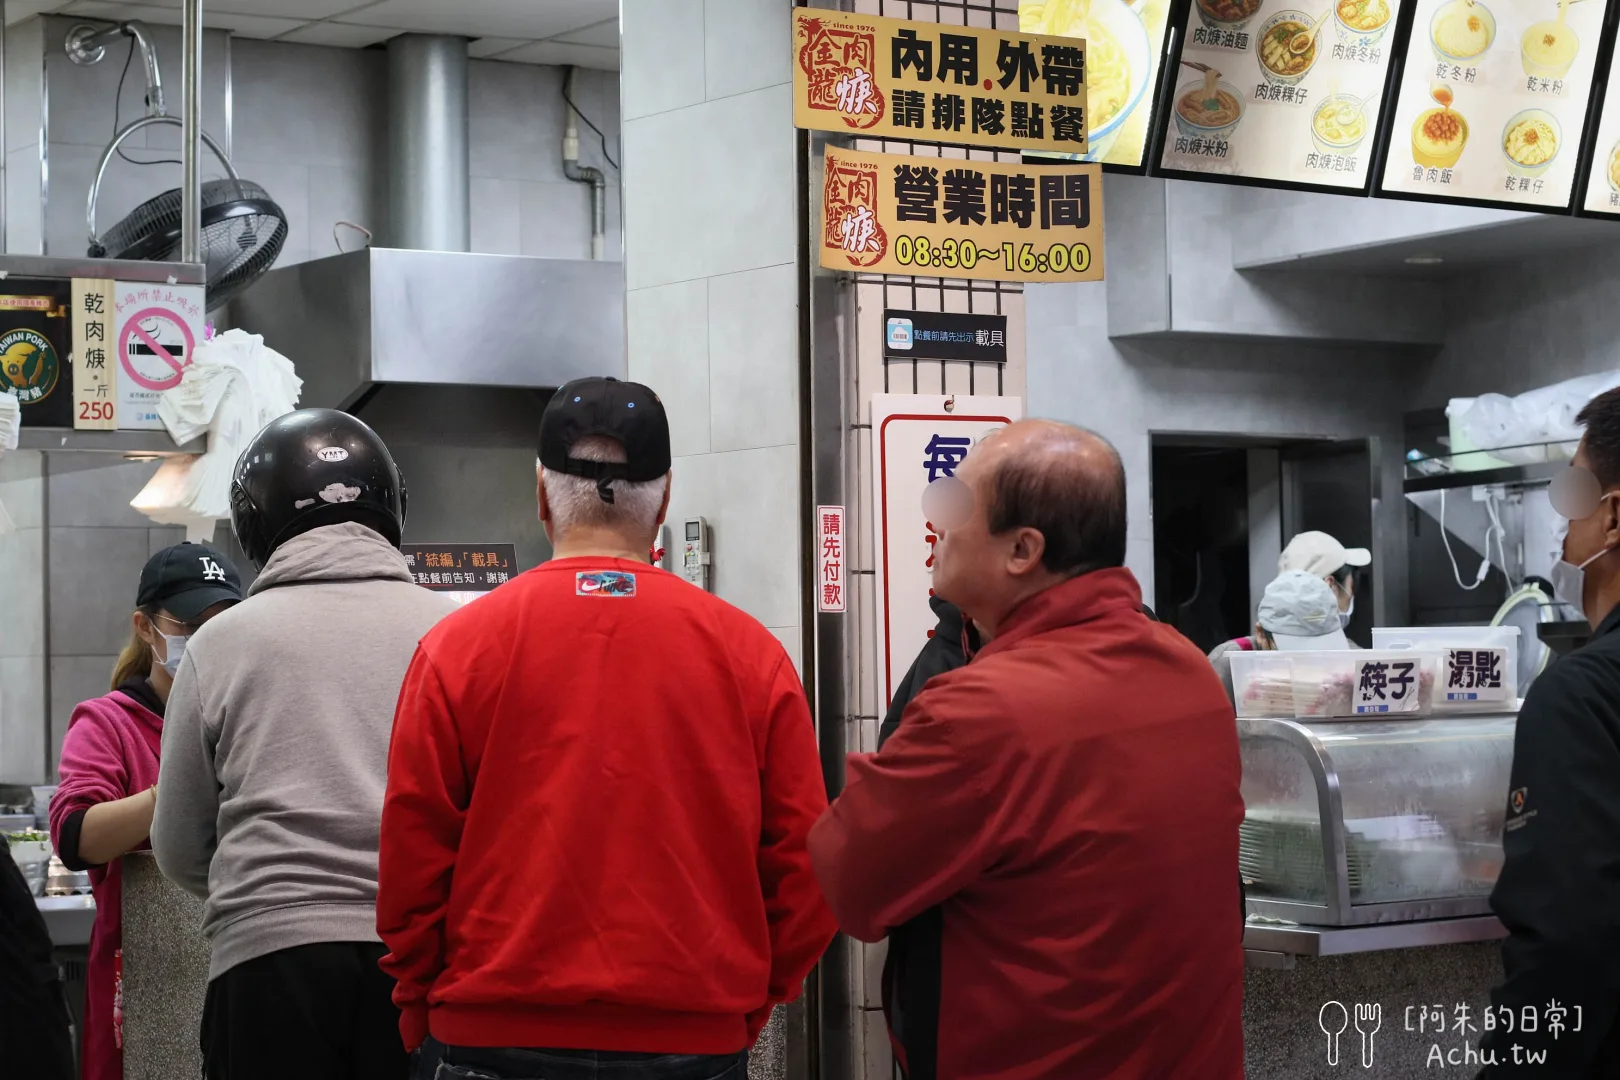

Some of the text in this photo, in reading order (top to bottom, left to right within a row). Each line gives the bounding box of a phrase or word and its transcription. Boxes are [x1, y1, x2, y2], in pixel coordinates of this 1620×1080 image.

[833, 22, 876, 32] since 1976
[1193, 28, 1249, 50] 肉焿油麵
[1332, 44, 1382, 65] 肉焿冬粉
[1435, 63, 1477, 83] 乾冬粉
[1527, 76, 1564, 96] 乾米粉
[891, 89, 1084, 143] 請排隊點餐
[1174, 137, 1229, 159] 肉焿米粉
[859, 162, 878, 170] 1976
[1412, 165, 1454, 184] 魯肉飯
[1505, 176, 1544, 194] 乾粿仔
[893, 164, 1091, 230] 營業時間
[895, 234, 1091, 273] 08:30~16:00
[26, 333, 49, 352] PORK
[79, 401, 114, 420] 250
[199, 557, 226, 581] LA
[822, 513, 841, 606] 請先付款
[1359, 661, 1415, 701] 筷子
